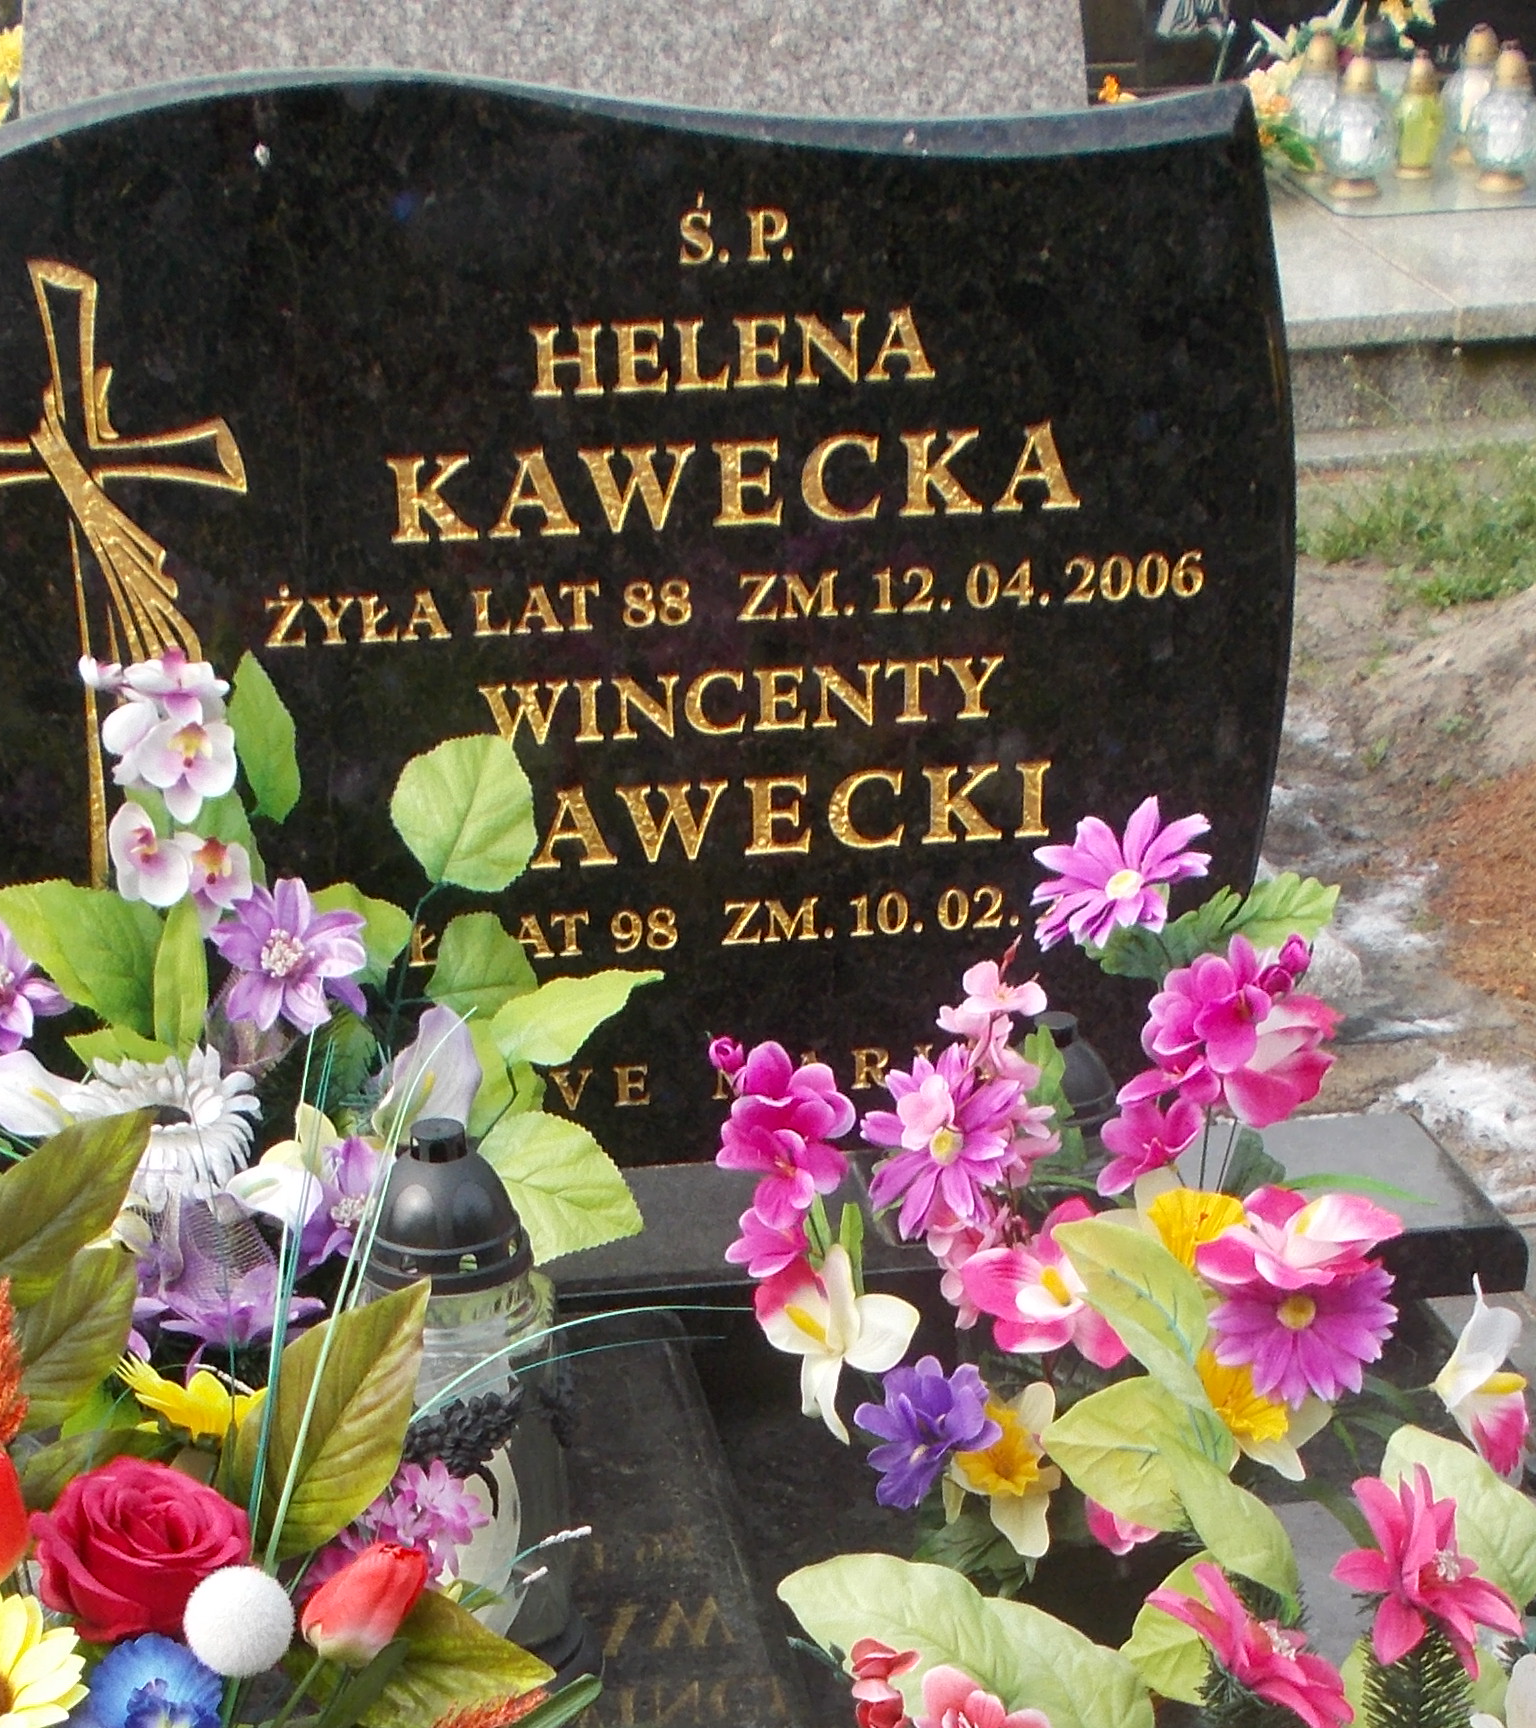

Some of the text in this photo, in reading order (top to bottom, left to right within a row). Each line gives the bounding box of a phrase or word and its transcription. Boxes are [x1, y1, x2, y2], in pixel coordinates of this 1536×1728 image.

[528, 303, 936, 399] HELENA
[385, 417, 1081, 545] KAWECKA
[264, 583, 452, 648] ŻYŁA
[470, 579, 600, 637] LAT
[622, 578, 692, 629] 88
[736, 566, 855, 622] ZM.
[477, 653, 1005, 746] WINCENTY
[530, 758, 1052, 870] AWECKI
[610, 904, 679, 953] 98
[721, 896, 835, 946] ZM.
